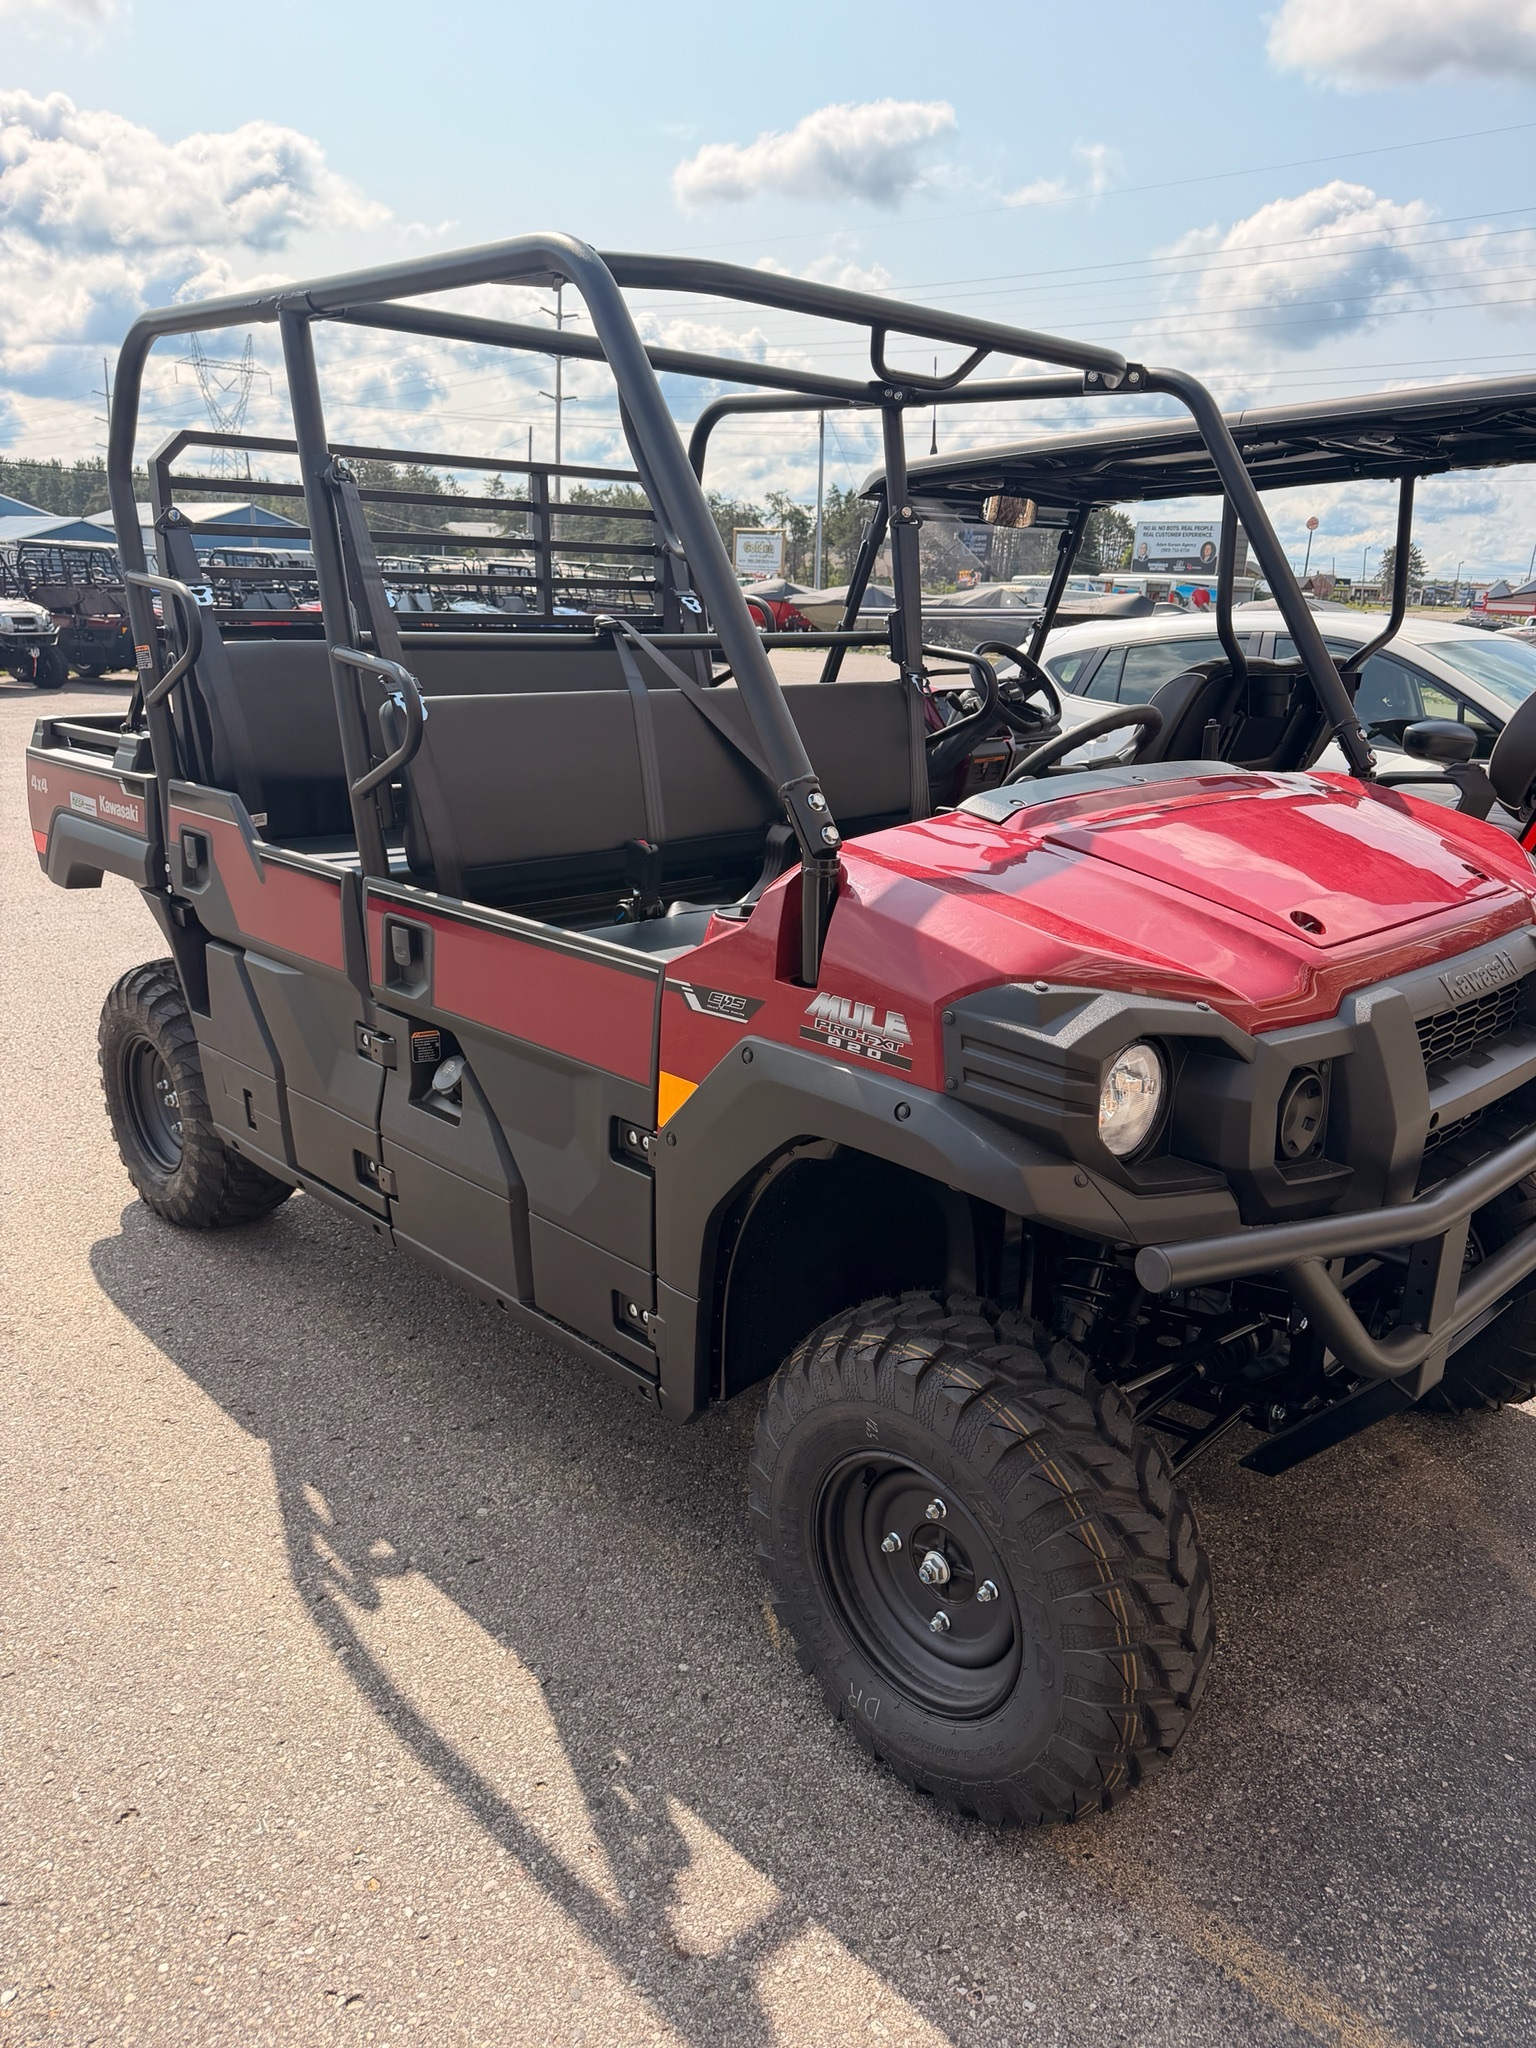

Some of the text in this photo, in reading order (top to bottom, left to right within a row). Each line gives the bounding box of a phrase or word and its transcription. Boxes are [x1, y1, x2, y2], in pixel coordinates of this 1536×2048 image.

[743, 541, 775, 554] Golden
[31, 774, 49, 794] 4x4
[99, 794, 139, 823] Kawasaki
[1438, 950, 1519, 1001] Kawasaki
[707, 991, 747, 1010] EPS
[804, 991, 914, 1045] MULE
[814, 1017, 904, 1053] PRO-FXT
[827, 1035, 882, 1060] 820
